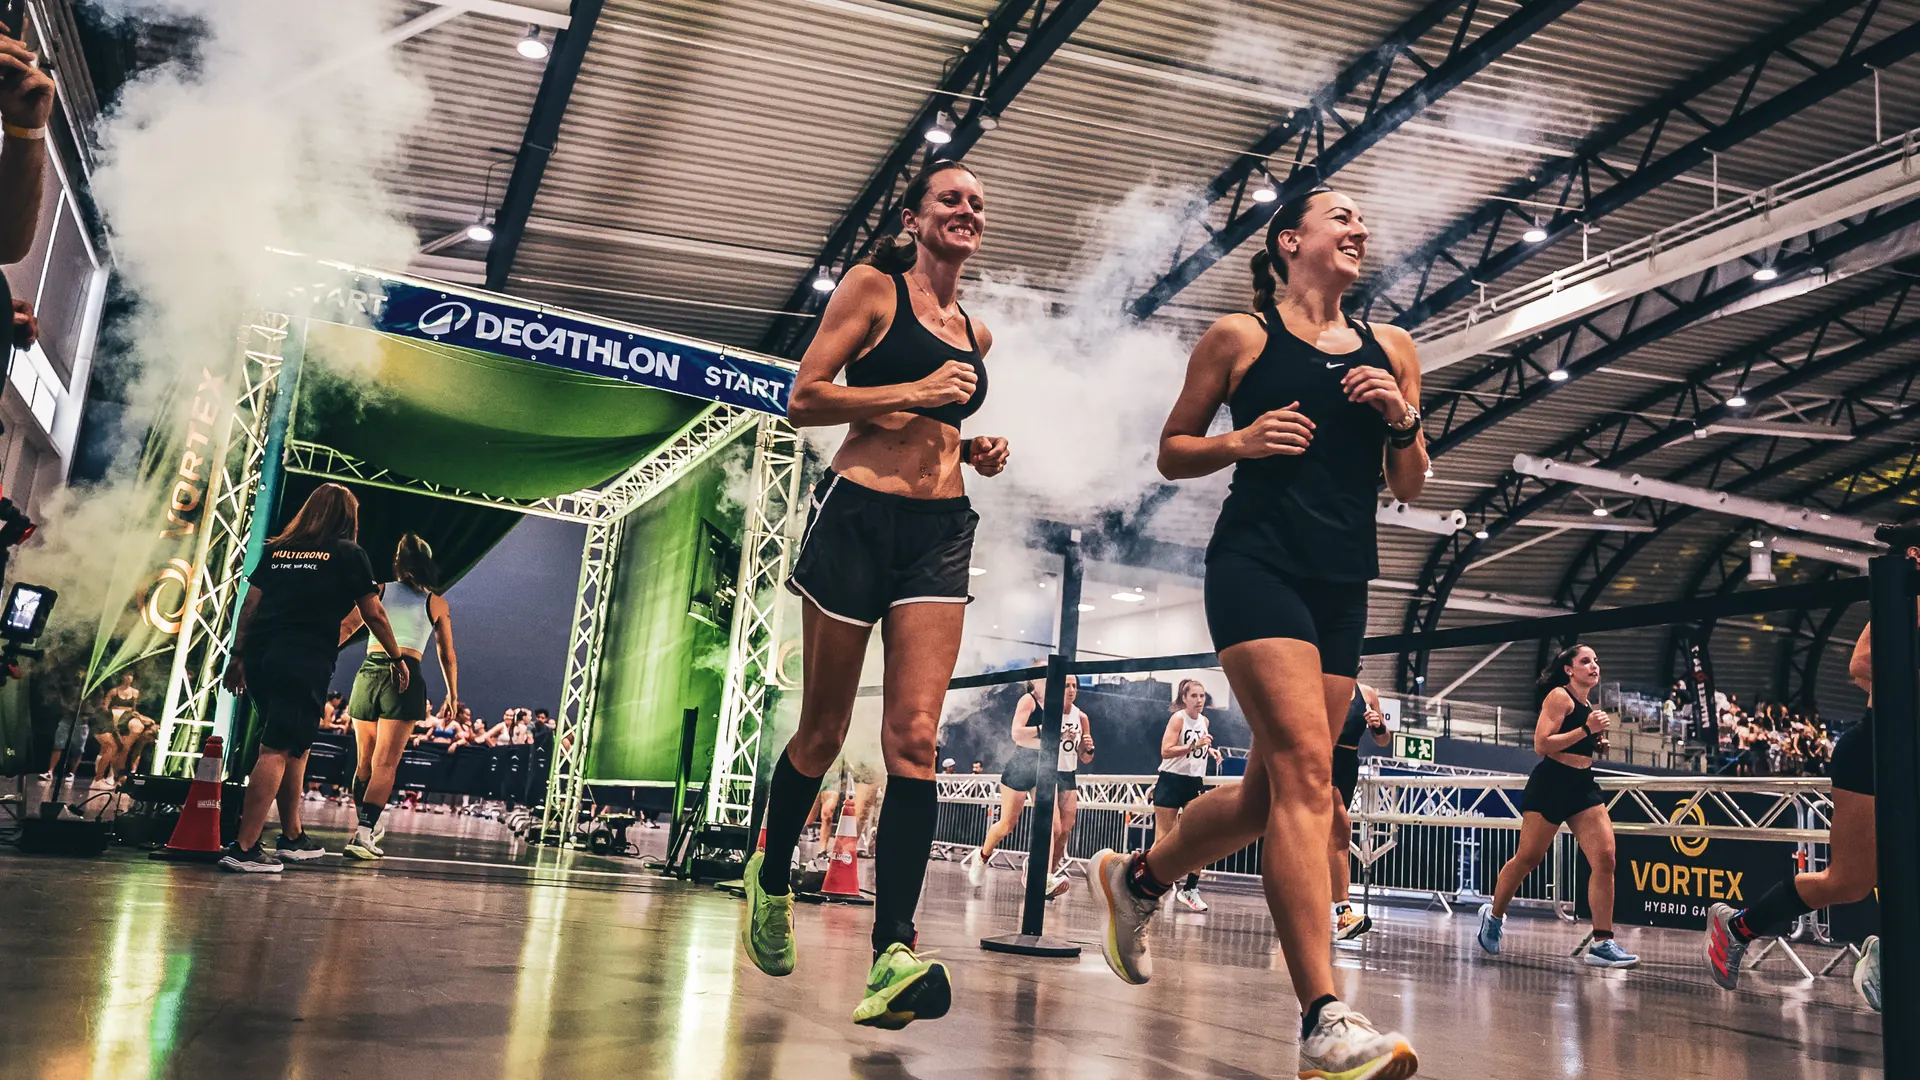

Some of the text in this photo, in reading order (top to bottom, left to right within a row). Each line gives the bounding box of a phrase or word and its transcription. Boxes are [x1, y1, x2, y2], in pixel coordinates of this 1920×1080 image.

[475, 311, 680, 381] DECATHLON
[704, 366, 785, 401] START
[159, 366, 228, 539] VORTEX
[271, 550, 331, 561] MULTICRONO
[1631, 860, 1743, 901] VORTEX
[1644, 901, 1709, 917] HYBRID GA
